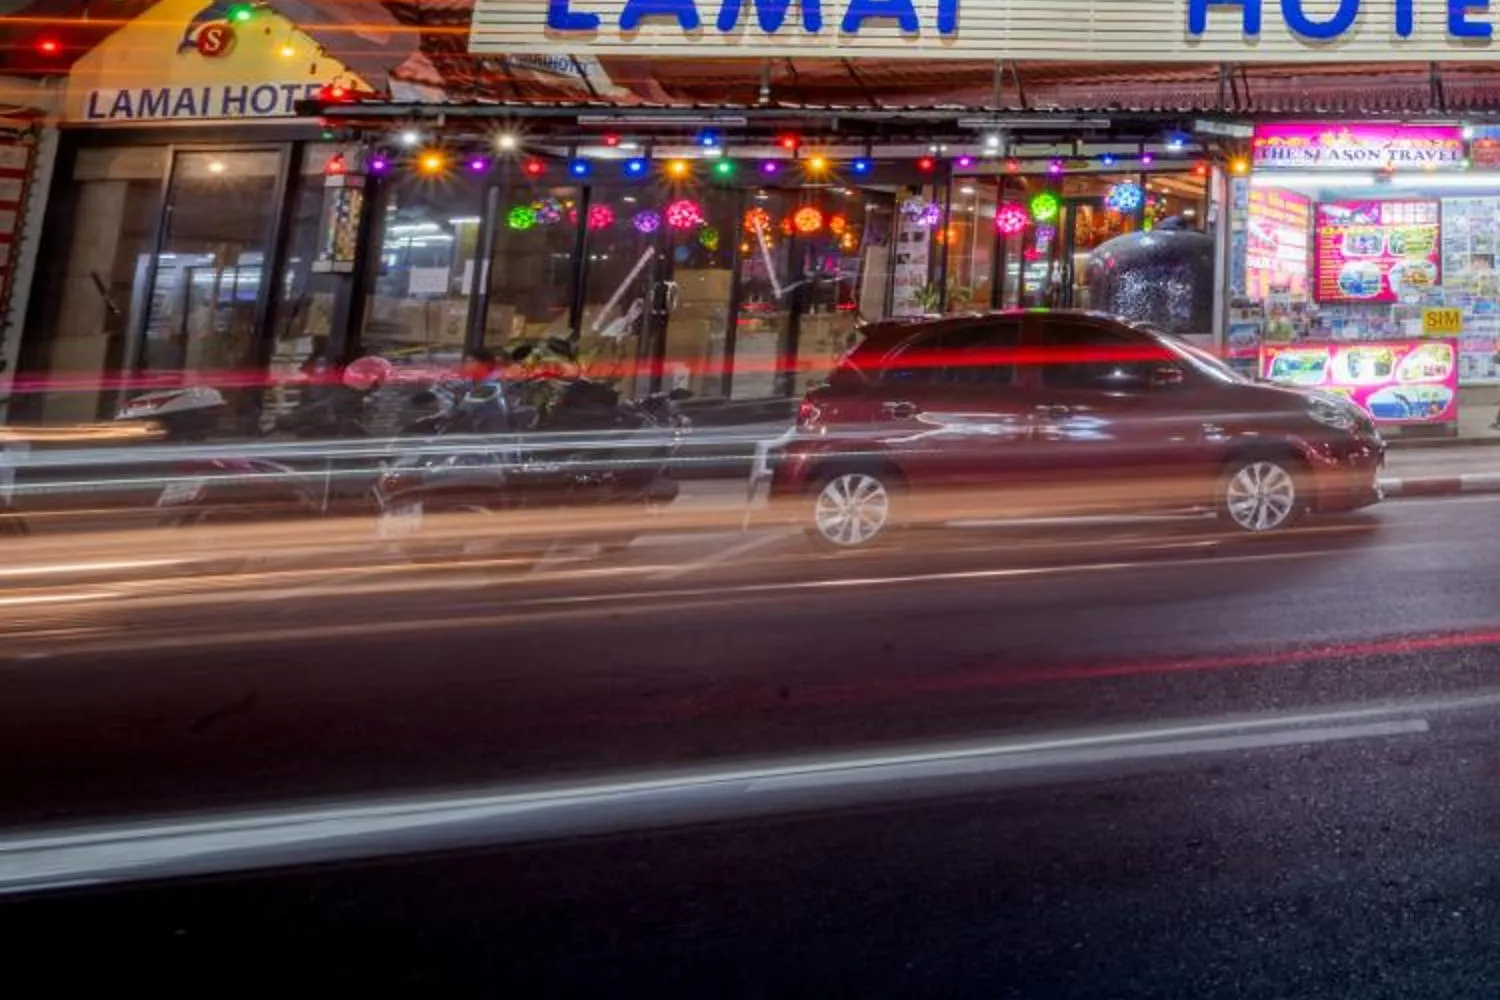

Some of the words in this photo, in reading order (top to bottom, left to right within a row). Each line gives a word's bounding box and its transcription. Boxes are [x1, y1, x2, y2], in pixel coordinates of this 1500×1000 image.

[204, 29, 222, 51] S
[87, 86, 212, 119] LAMAI
[221, 82, 324, 116] HOTE
[1387, 147, 1459, 162] TRAVEL
[1425, 310, 1461, 329] SIM
